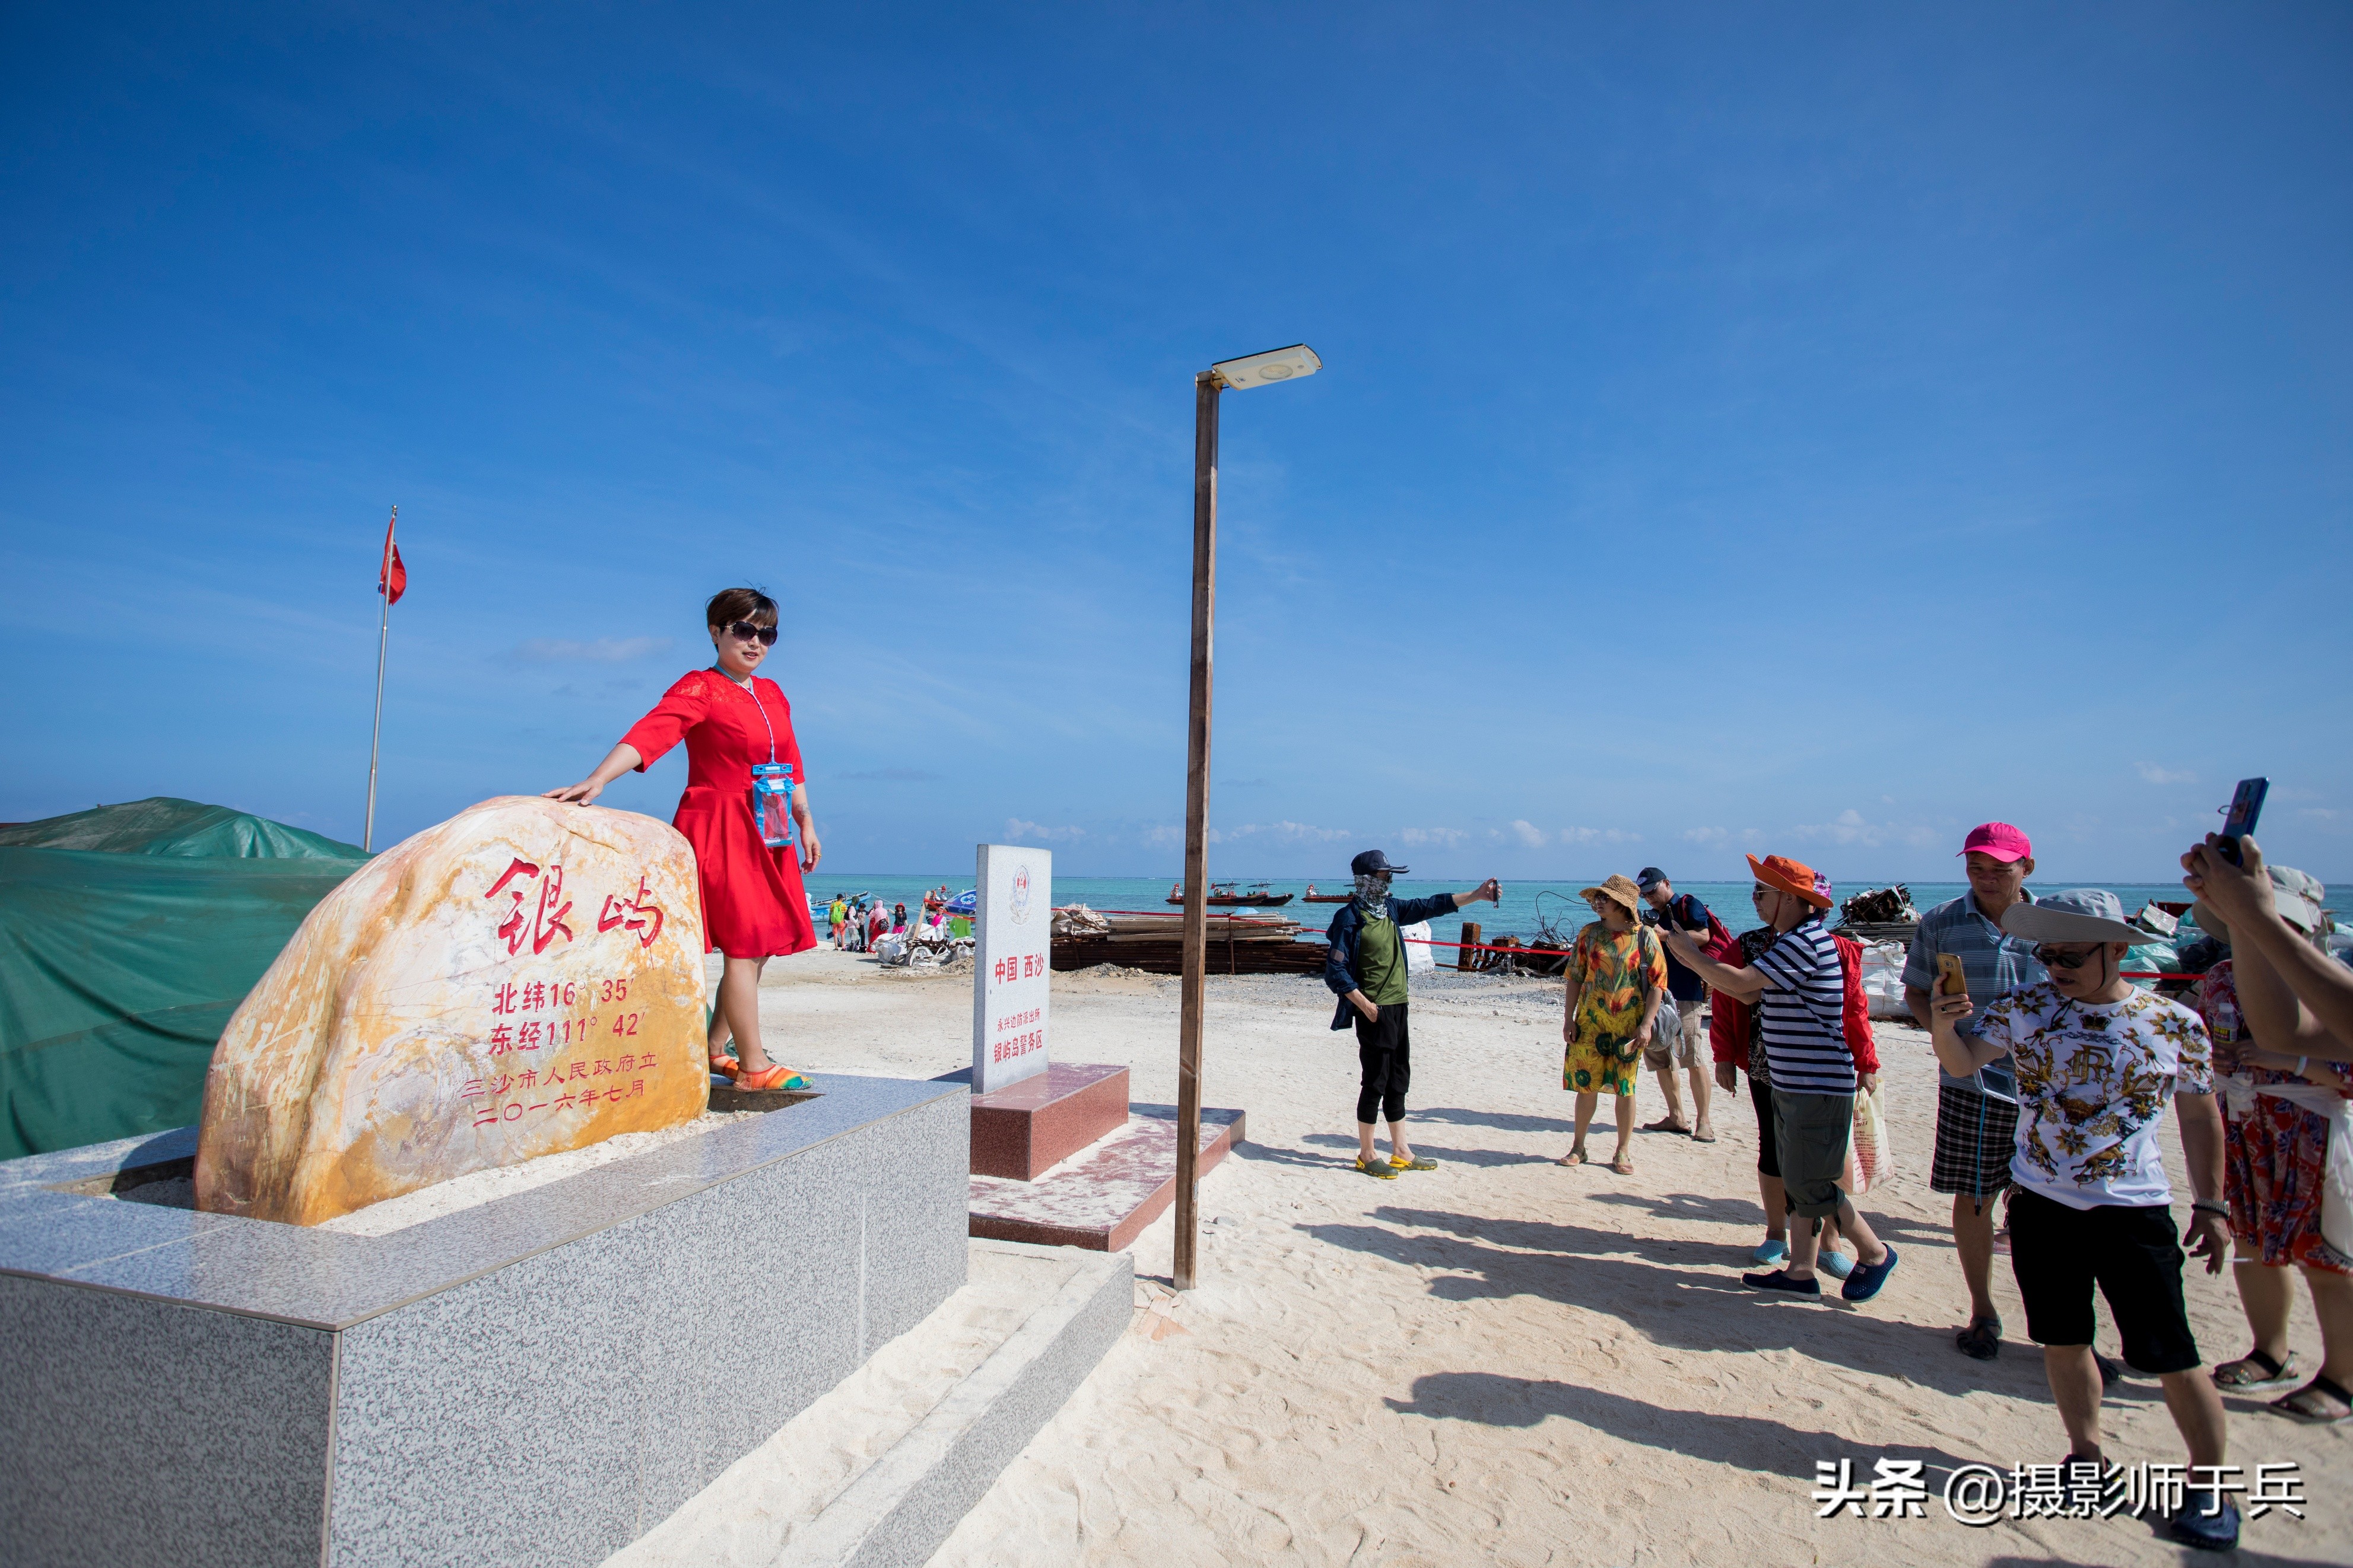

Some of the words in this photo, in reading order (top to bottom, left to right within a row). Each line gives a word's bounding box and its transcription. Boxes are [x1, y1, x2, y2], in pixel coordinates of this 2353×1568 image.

[995, 956, 1017, 985] 中国
[1024, 953, 1044, 978] 西沙
[997, 1008, 1040, 1032] 永兴边防派出所
[994, 1029, 1042, 1064] 银屿岛警务区
[461, 1052, 658, 1098] 三沙市人民政府立
